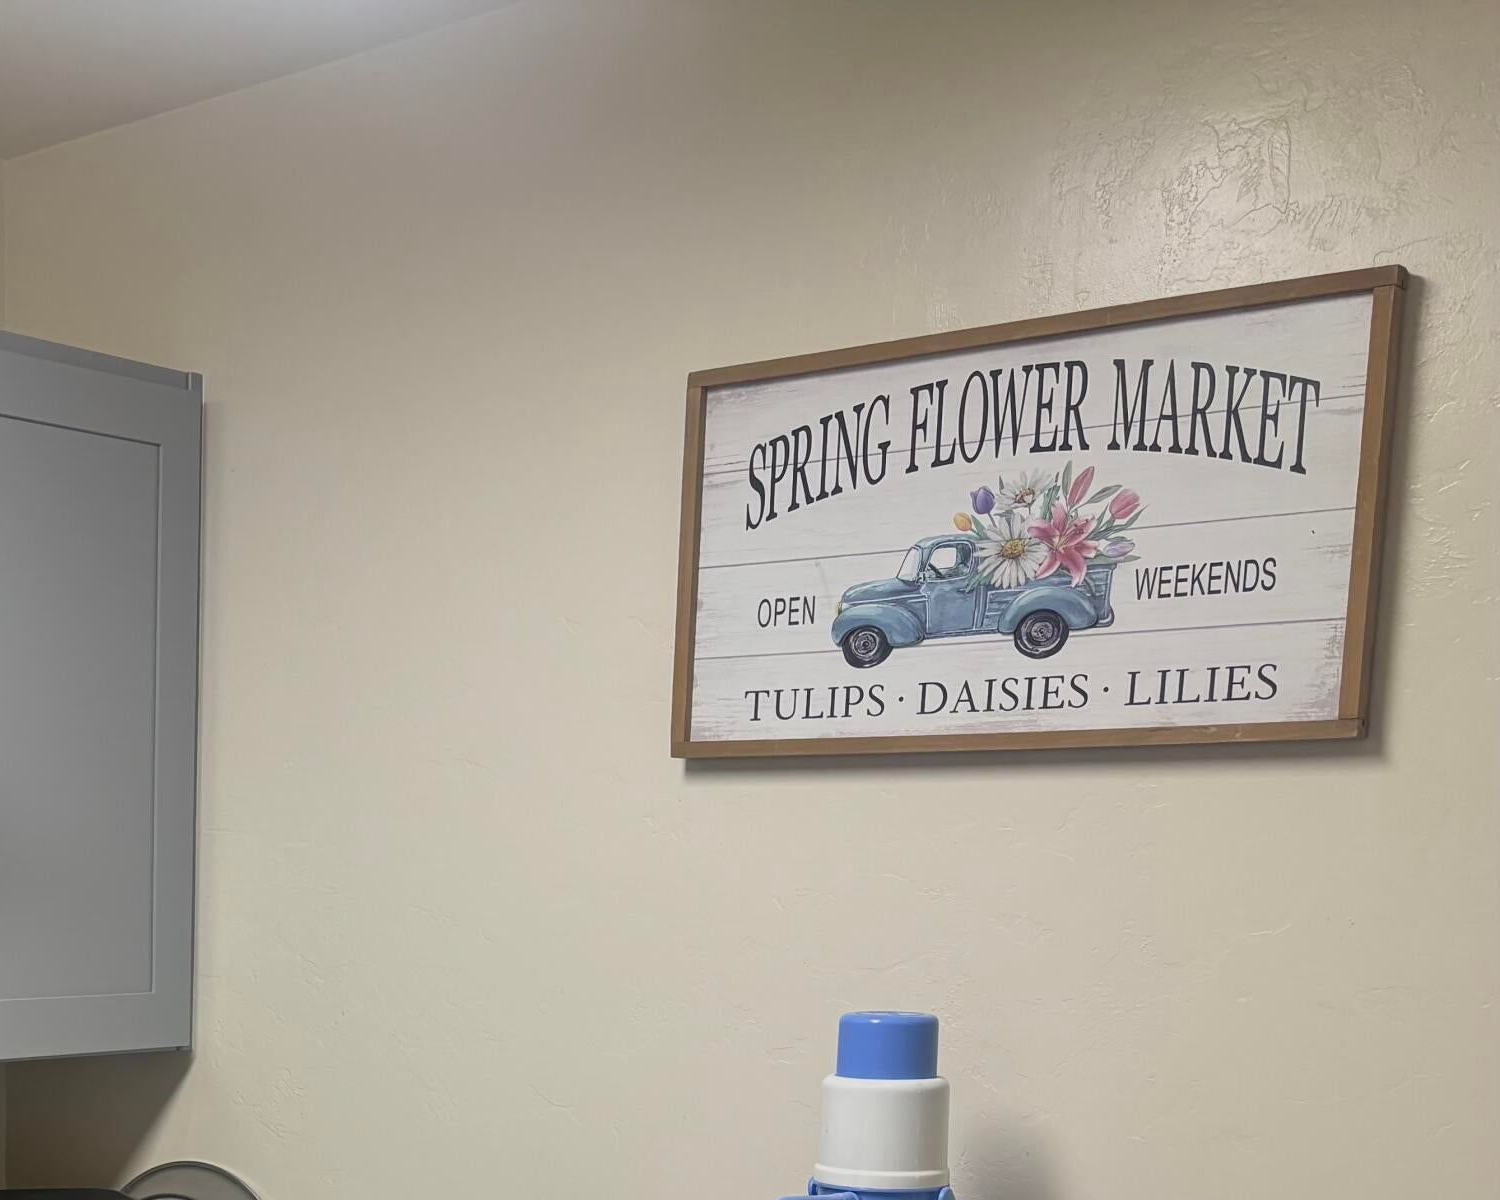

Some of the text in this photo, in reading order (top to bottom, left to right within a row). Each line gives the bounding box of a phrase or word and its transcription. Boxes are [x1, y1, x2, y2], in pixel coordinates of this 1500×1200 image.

[744, 358, 1322, 530] SPRING FLOWER MARKET
[1135, 557, 1277, 600] WEEKENDS
[757, 595, 817, 628] OPEN
[745, 663, 1279, 722] TULIPS DAISIES LILIES
